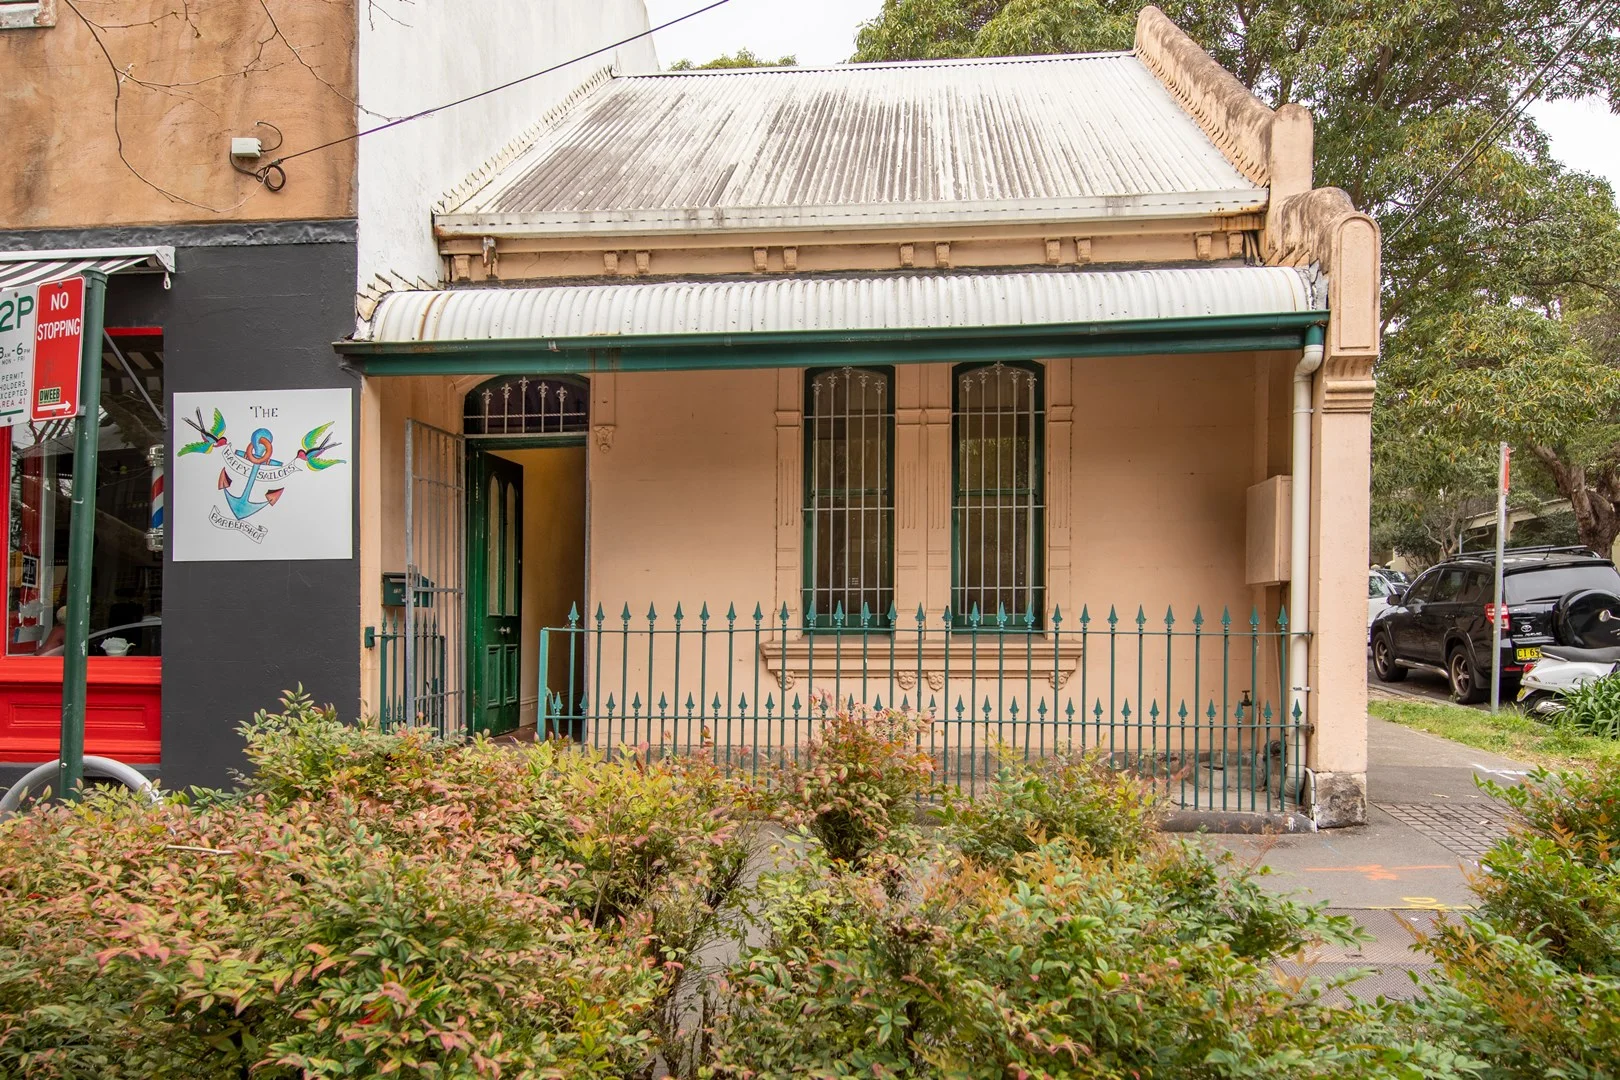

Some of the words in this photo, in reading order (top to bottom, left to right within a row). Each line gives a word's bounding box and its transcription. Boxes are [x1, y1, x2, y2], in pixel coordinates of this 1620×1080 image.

[51, 291, 69, 311] NO
[0, 295, 34, 333] 2P
[37, 317, 80, 341] STOPPING
[1, 371, 24, 382] PERMIT
[0, 388, 27, 400] XCEPTED
[0, 399, 15, 408] REA
[250, 405, 278, 418] THE
[224, 448, 250, 475] HAPPY
[257, 463, 296, 480] SAILORS
[211, 512, 265, 540] BARBERSHOP
